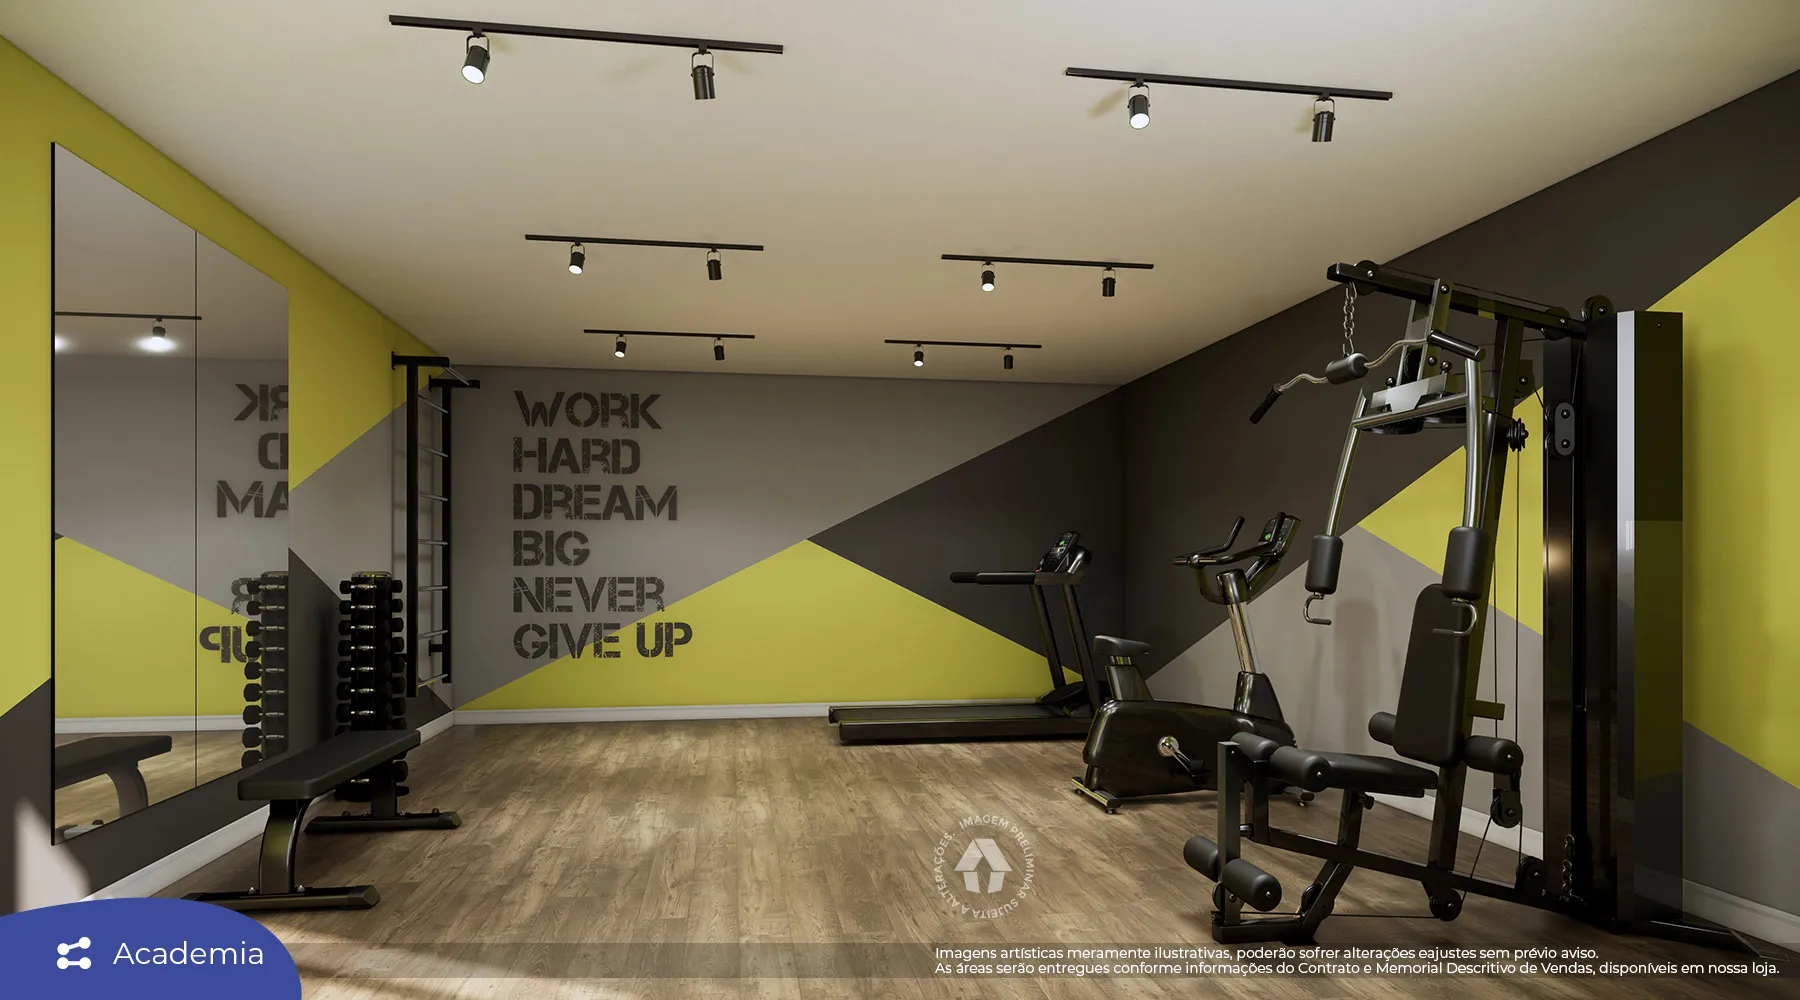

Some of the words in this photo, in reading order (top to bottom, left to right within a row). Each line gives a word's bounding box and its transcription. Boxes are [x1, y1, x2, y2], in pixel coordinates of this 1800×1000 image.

[513, 390, 663, 429] WORK
[513, 437, 641, 475] HARD
[513, 483, 678, 521] DREAM
[513, 530, 591, 567] BIG
[513, 576, 666, 613] NEVER
[513, 622, 621, 659] GIVE
[636, 622, 693, 658] UP
